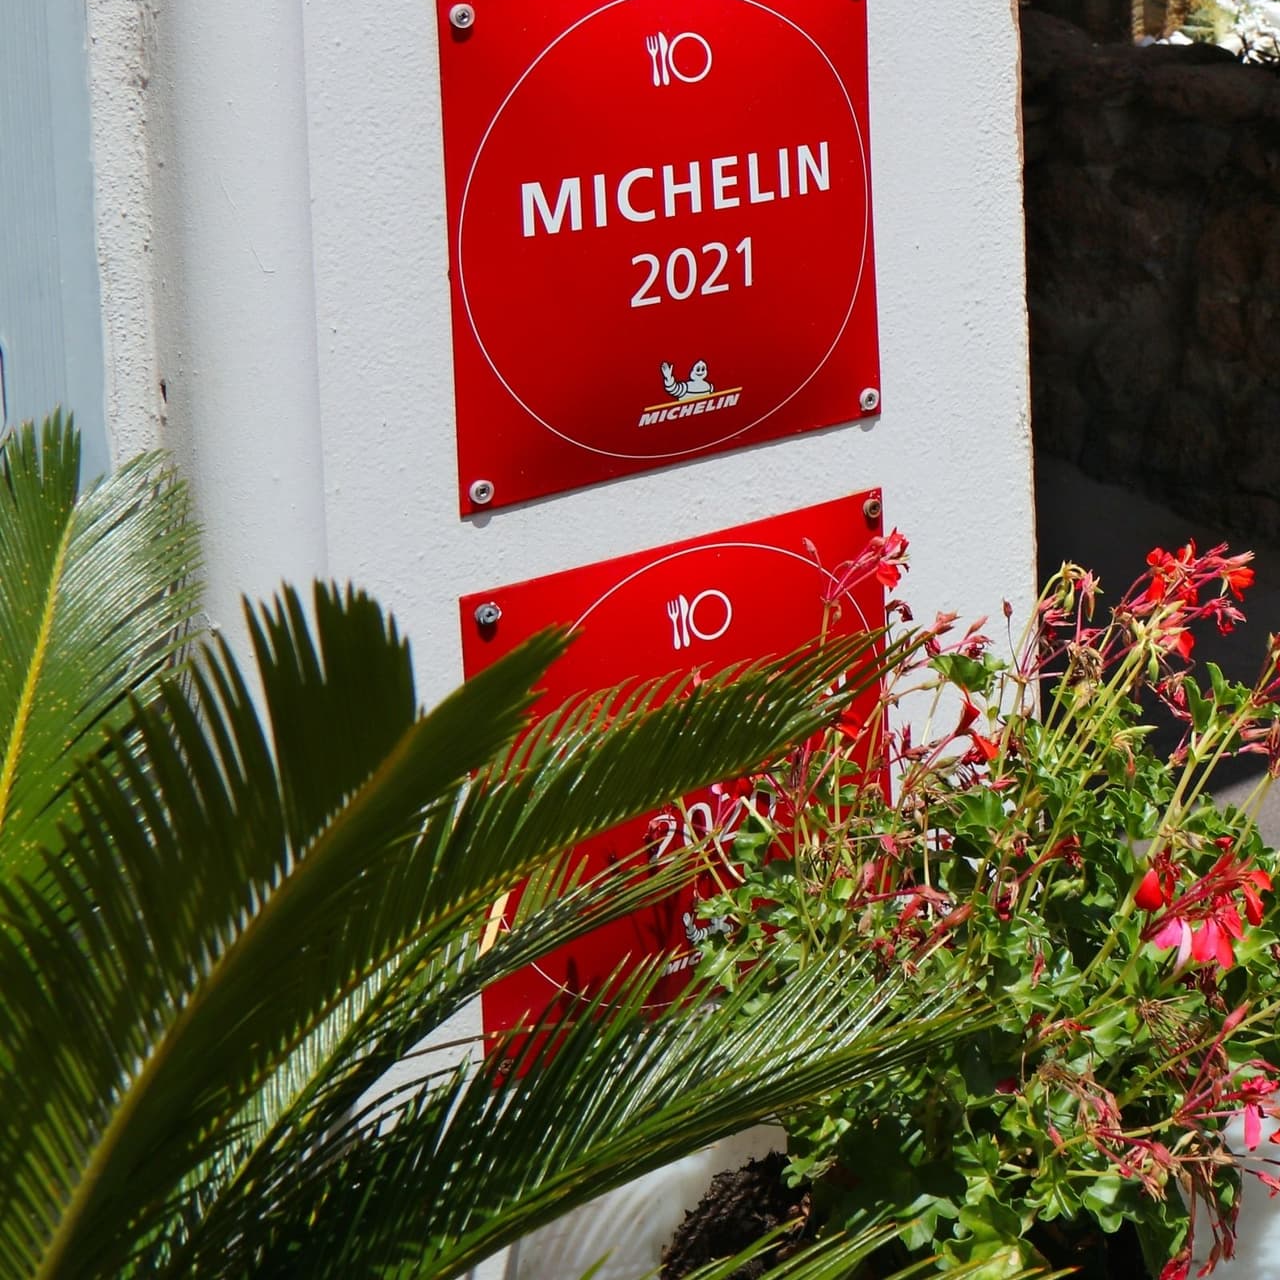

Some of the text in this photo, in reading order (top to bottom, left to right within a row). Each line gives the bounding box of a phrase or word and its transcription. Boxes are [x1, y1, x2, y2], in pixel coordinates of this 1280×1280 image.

[521, 141, 830, 238] MICHELIN
[630, 236, 753, 308] 2021
[638, 393, 740, 427] MICHELIN
